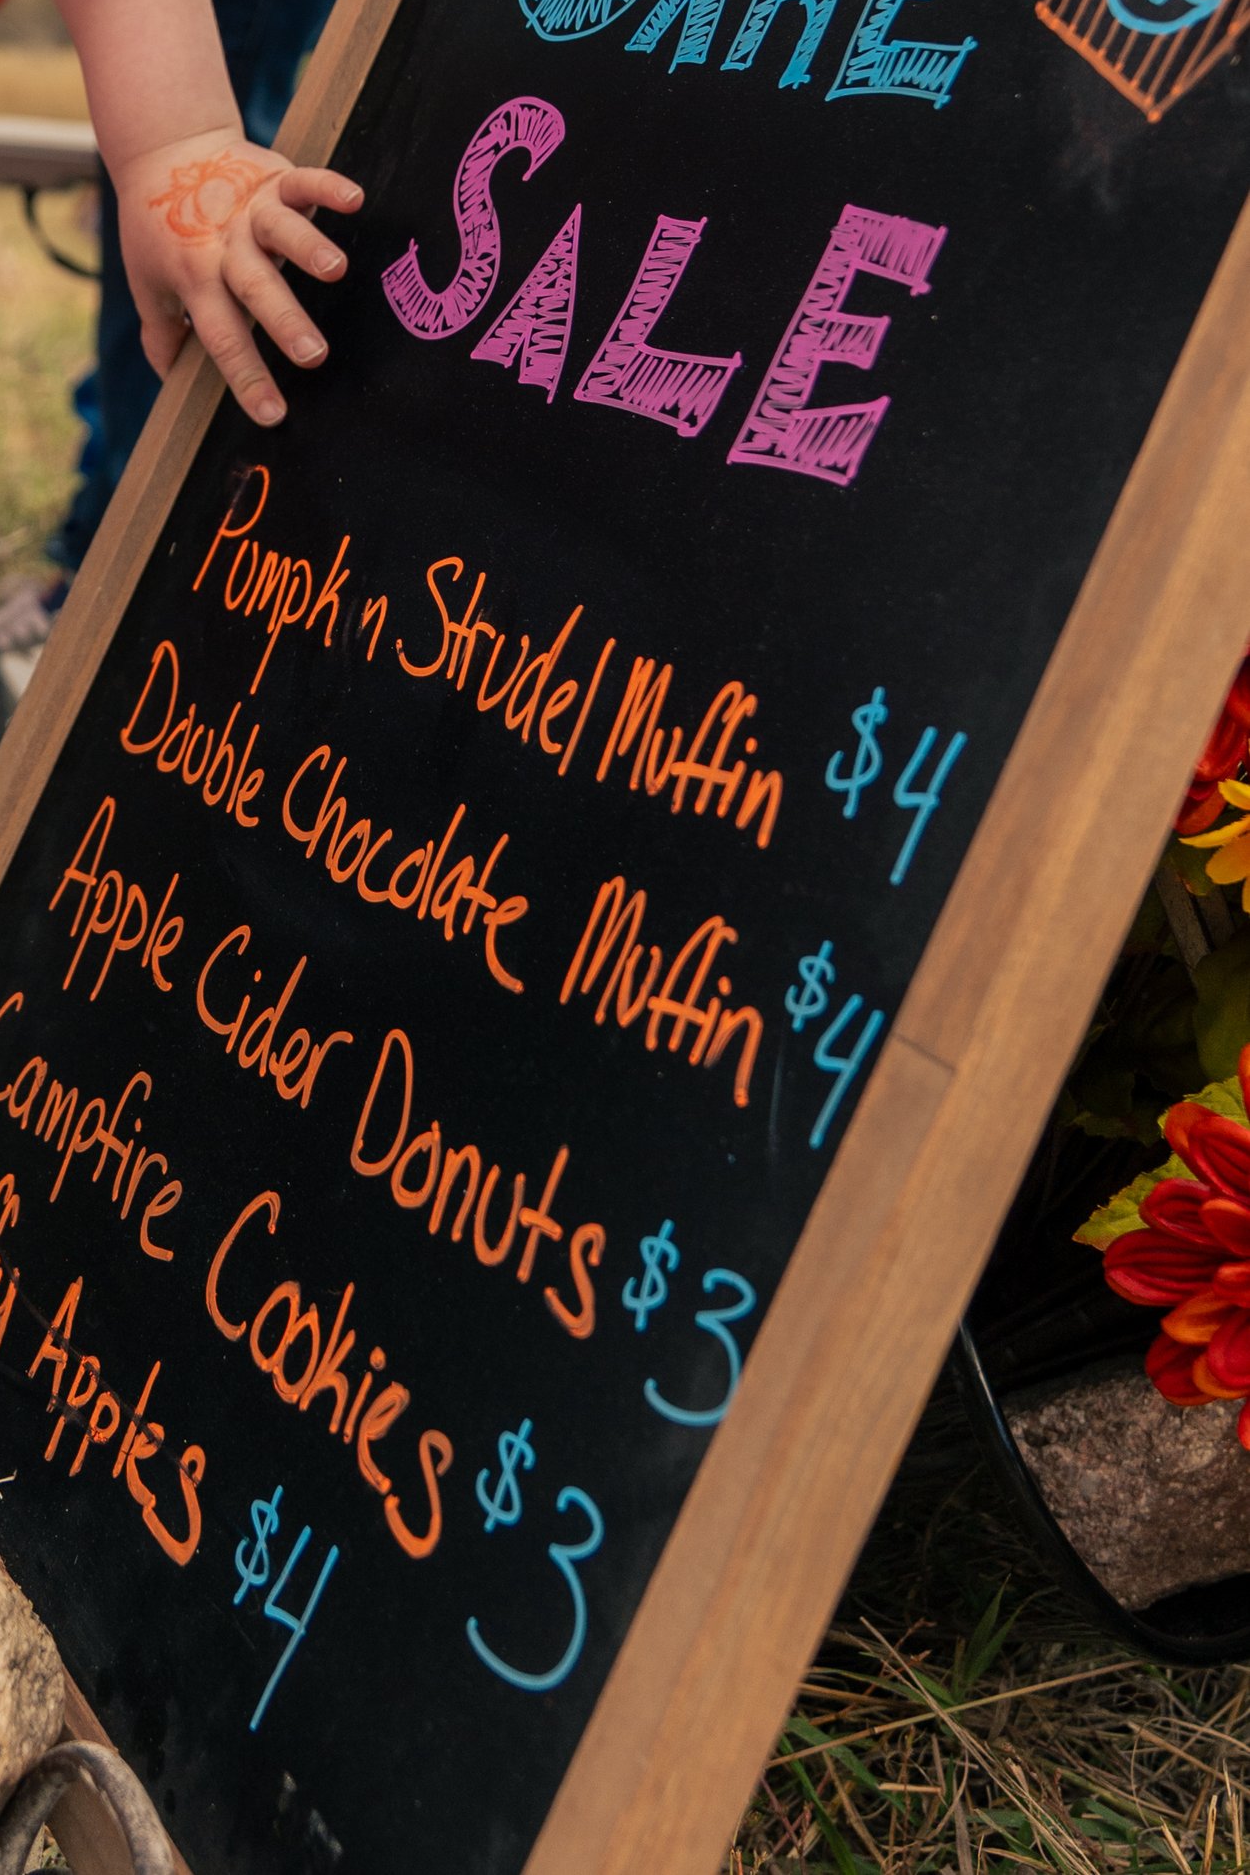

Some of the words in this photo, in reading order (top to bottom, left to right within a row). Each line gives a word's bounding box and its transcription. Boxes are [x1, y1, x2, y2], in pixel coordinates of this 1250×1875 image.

[381, 96, 948, 486] SALE
[193, 465, 388, 696] Pumpkn
[396, 557, 616, 776] Strudel
[596, 656, 783, 849] Muffin
[49, 796, 184, 1001] Apple
[197, 925, 353, 1108] Cider
[351, 1029, 605, 1338] Donuts
[121, 640, 264, 827] Double
[283, 745, 528, 993] Chocolate
[560, 876, 763, 1107] Muffin
[30, 1277, 205, 1565] Apples
[206, 1191, 454, 1558] Cookies
